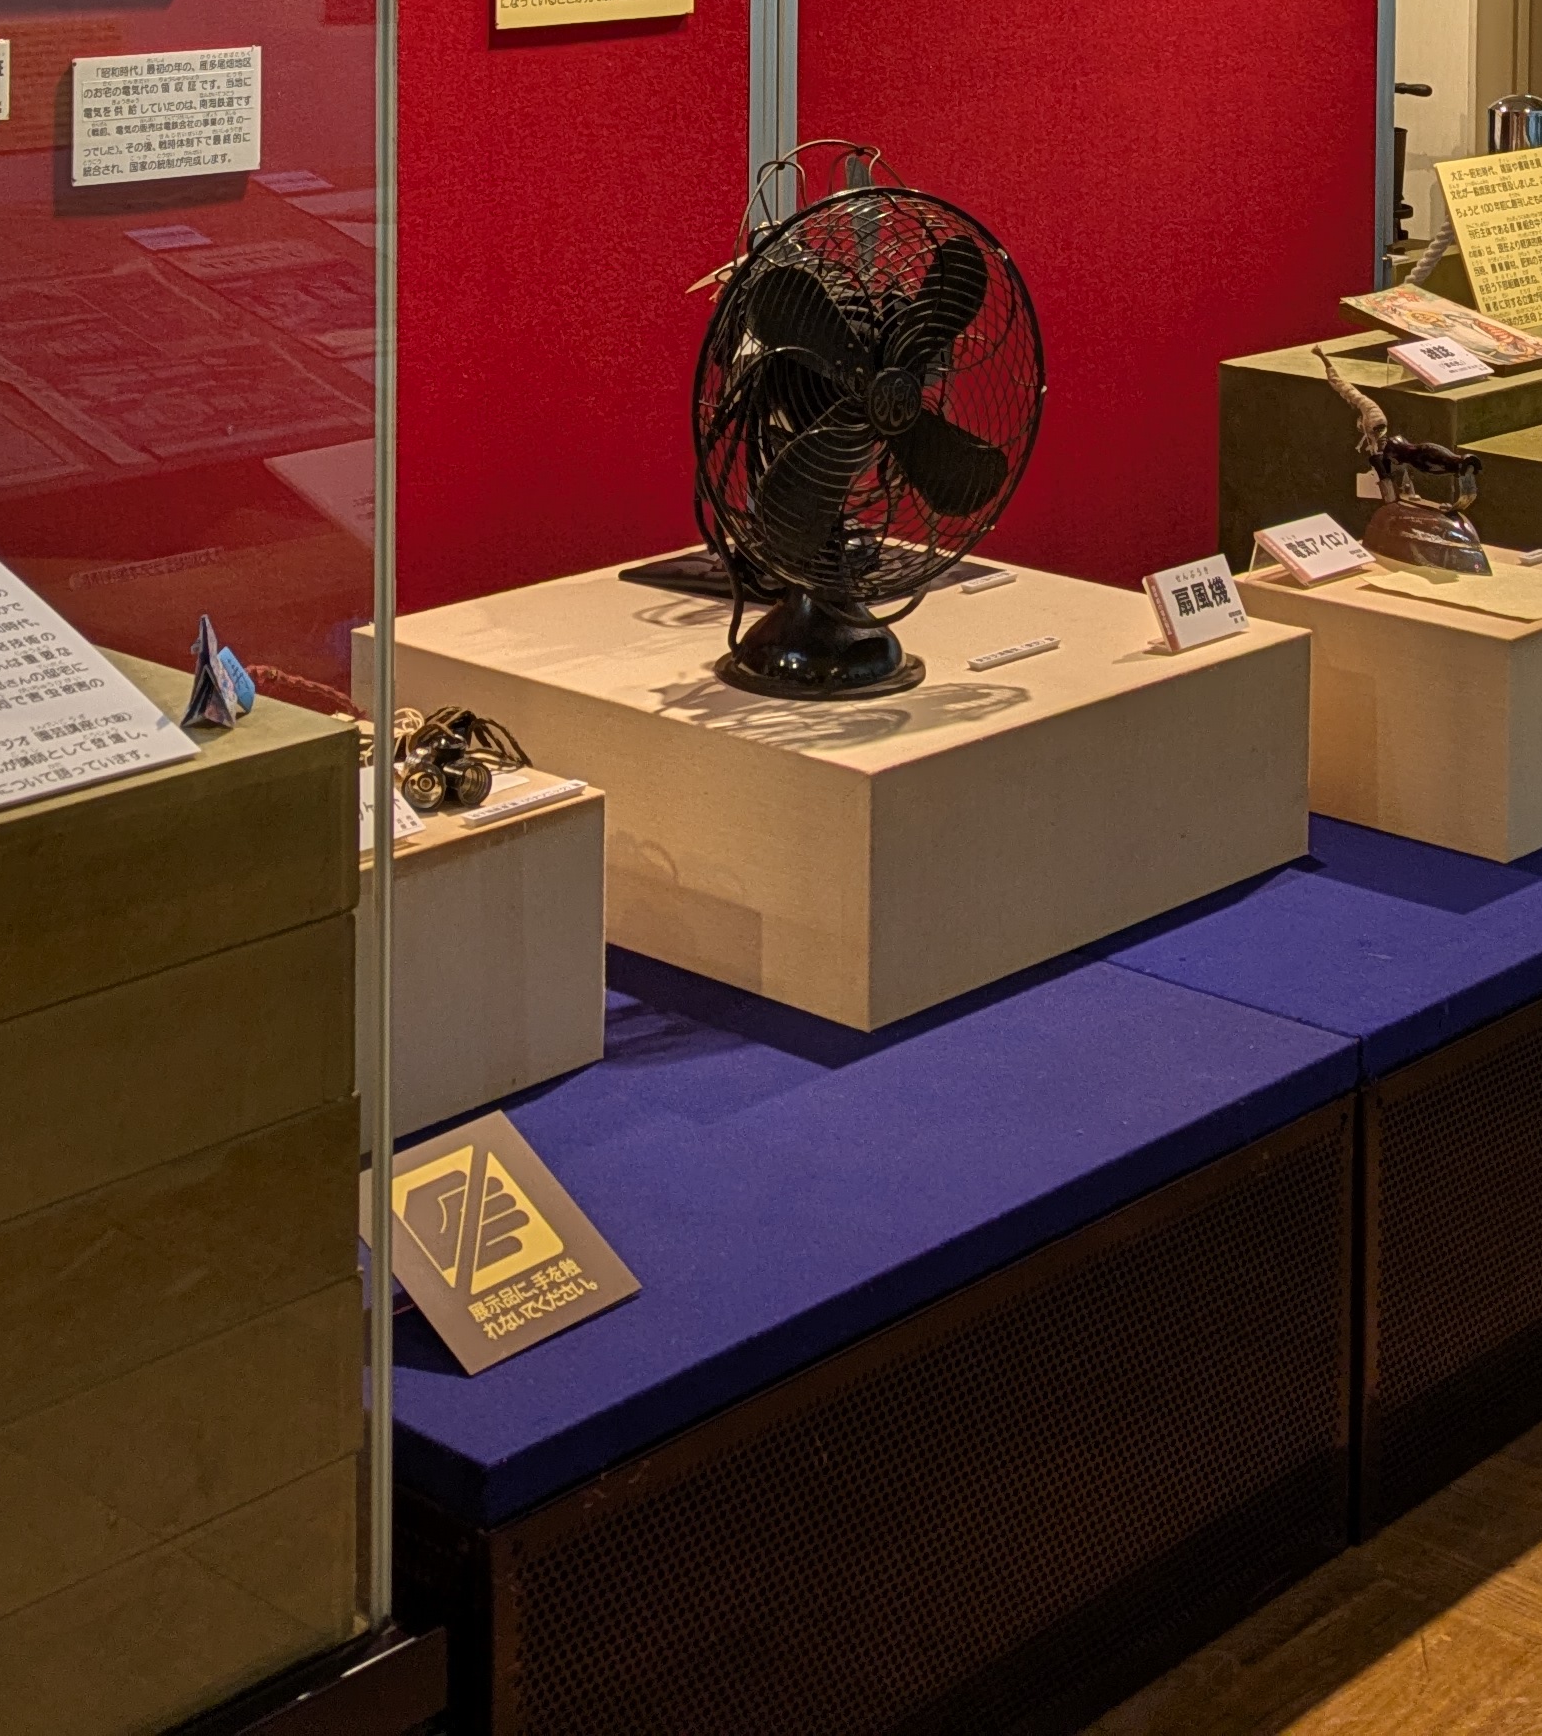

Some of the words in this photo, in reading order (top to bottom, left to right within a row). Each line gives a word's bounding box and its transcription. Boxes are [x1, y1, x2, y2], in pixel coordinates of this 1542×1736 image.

[1284, 531, 1349, 560] 電気アイロン
[1170, 575, 1232, 618] 扇風機
[467, 1257, 583, 1323] 展示品に、手を触
[482, 1277, 600, 1342] れないでください。
